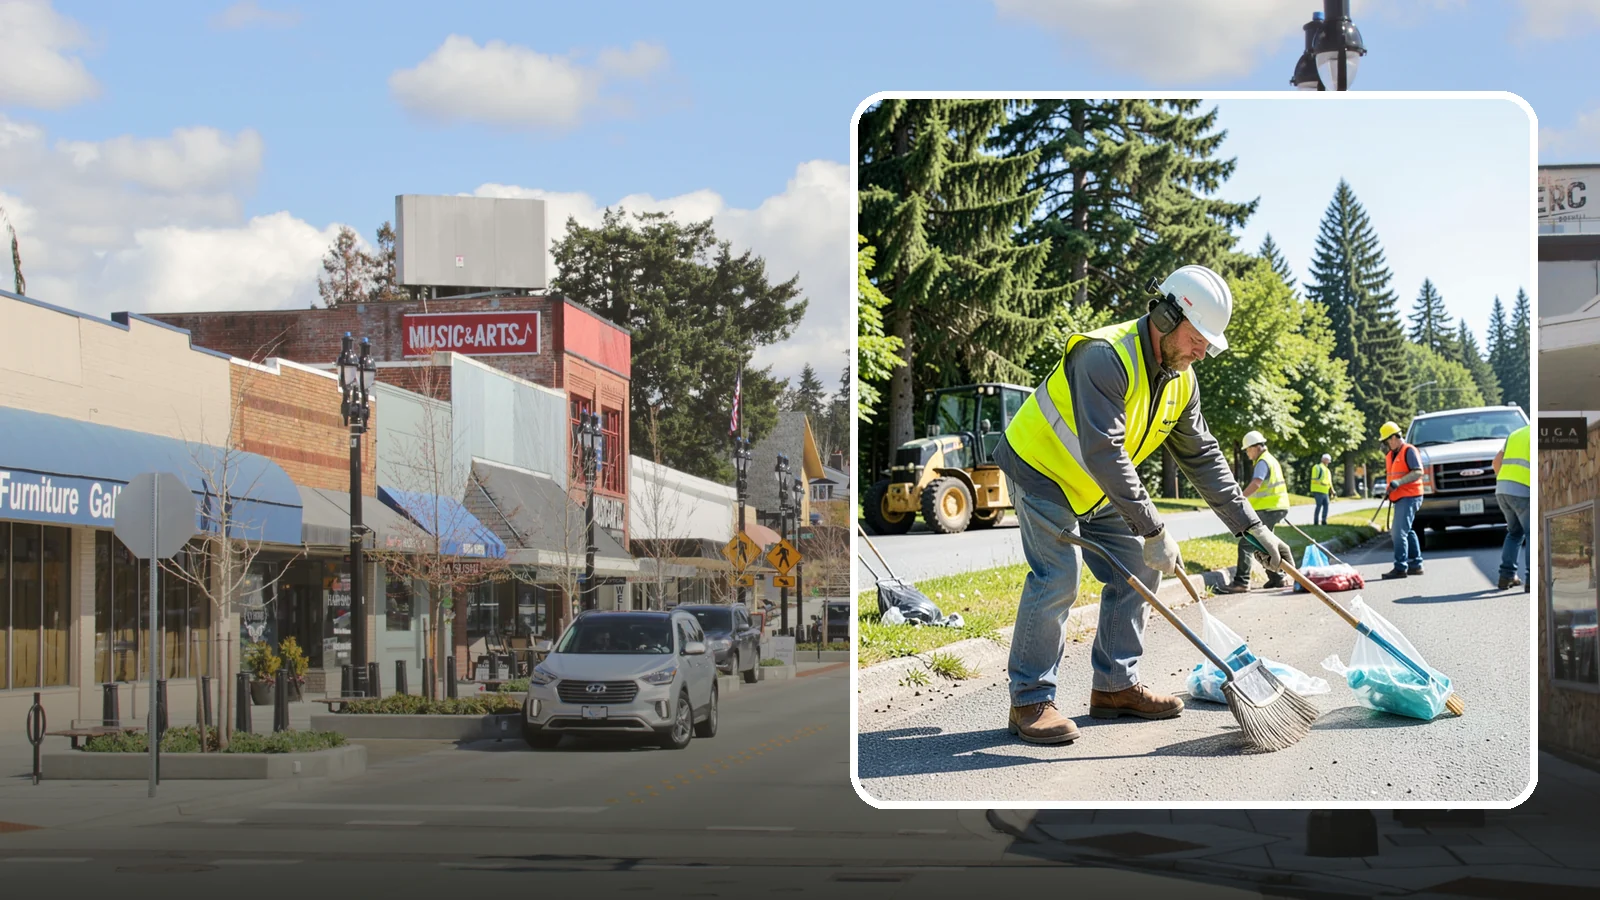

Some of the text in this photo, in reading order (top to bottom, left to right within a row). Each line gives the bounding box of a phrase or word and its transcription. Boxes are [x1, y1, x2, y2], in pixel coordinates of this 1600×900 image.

[0, 471, 121, 519] Furniture Gal
[453, 563, 480, 575] SUSHI
